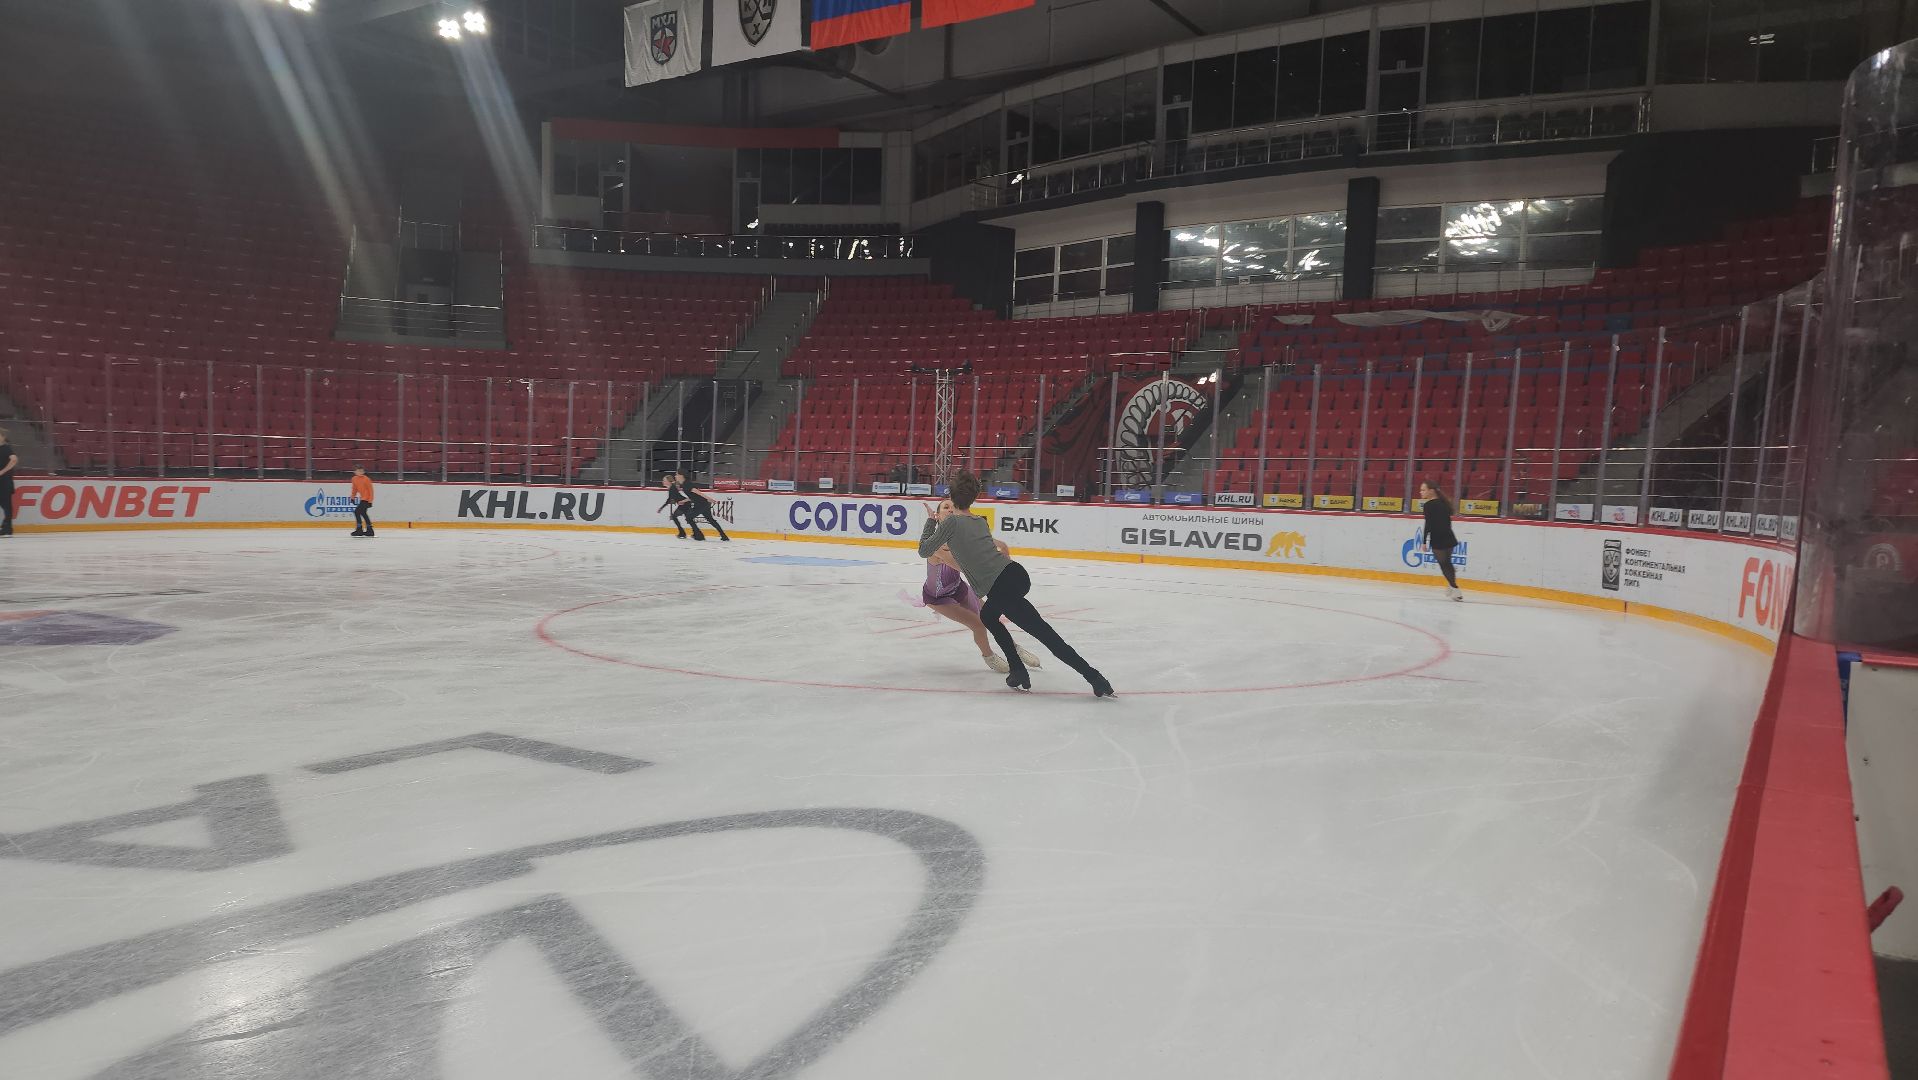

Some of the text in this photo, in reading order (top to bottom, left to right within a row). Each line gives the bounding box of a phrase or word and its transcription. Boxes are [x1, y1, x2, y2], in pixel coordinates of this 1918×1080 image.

[651, 13, 676, 29] МХЛ
[11, 485, 211, 520] FONBET
[326, 496, 361, 506] ГАЗПРО
[457, 489, 606, 521] KHL.RU
[1216, 495, 1252, 504] KHL.RU
[1142, 513, 1264, 526] АВТОМОБИЛЬНЫЕ ШИНЫ
[1651, 510, 1680, 523] KHL.RU
[1690, 512, 1718, 526] KHL.RU
[1001, 516, 1060, 534] БАНК
[1121, 527, 1263, 552] GISLAVED
[1625, 547, 1652, 558] ФОНБЕТ
